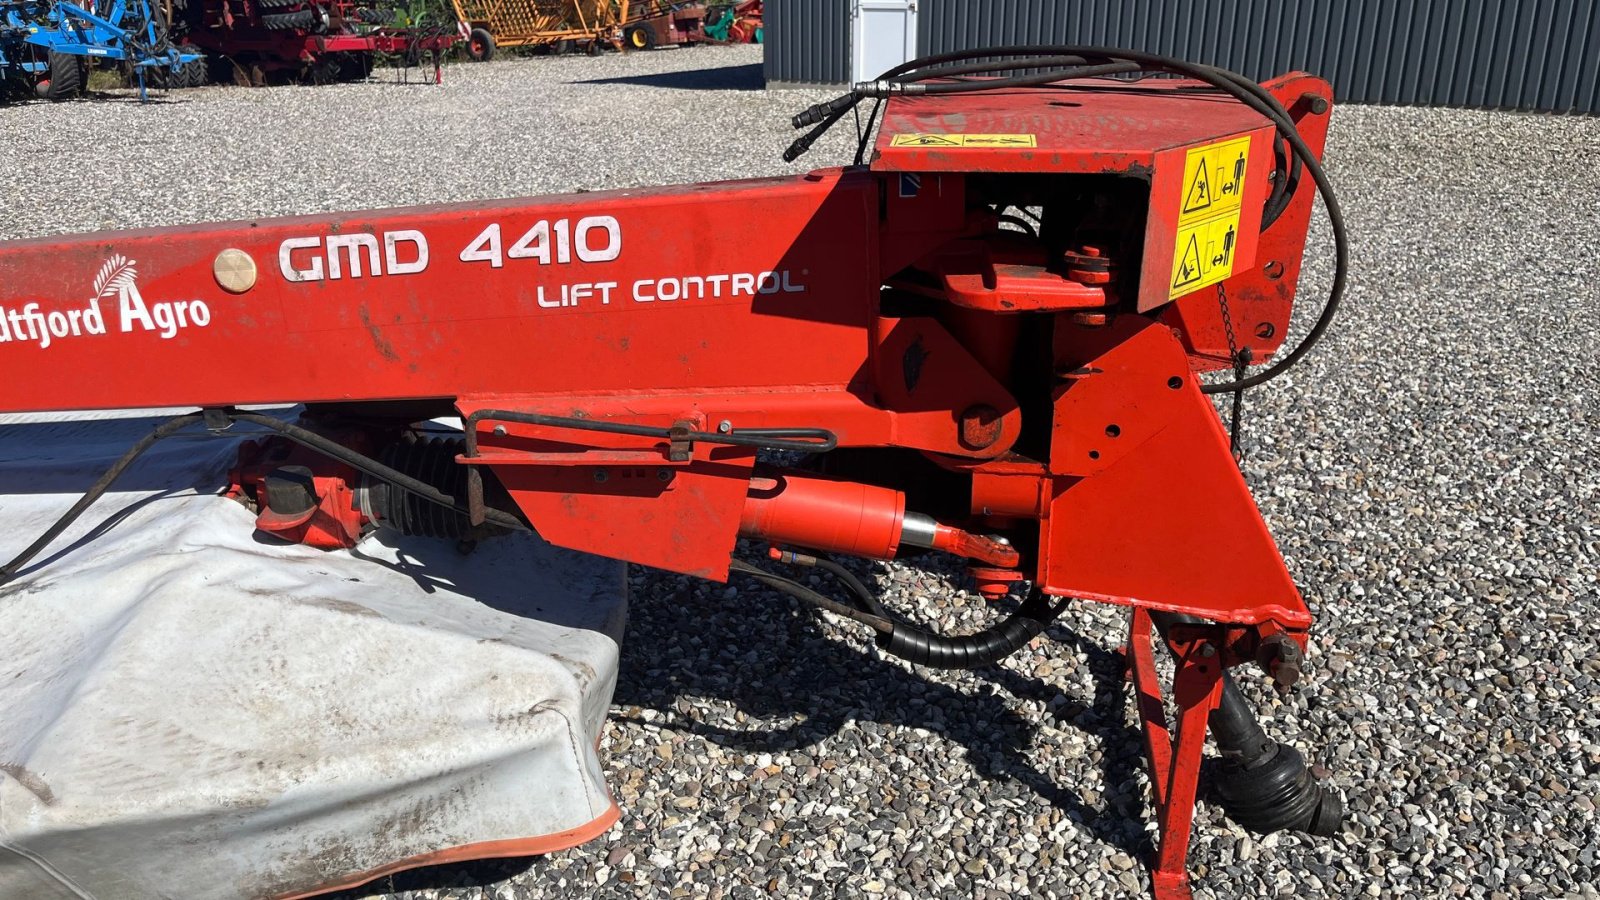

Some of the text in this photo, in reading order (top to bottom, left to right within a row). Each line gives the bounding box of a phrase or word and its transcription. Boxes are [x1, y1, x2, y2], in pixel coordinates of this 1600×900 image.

[278, 215, 622, 282] GMD 4410
[119, 279, 211, 339] Agro
[537, 270, 805, 308] LIFT CONTROL
